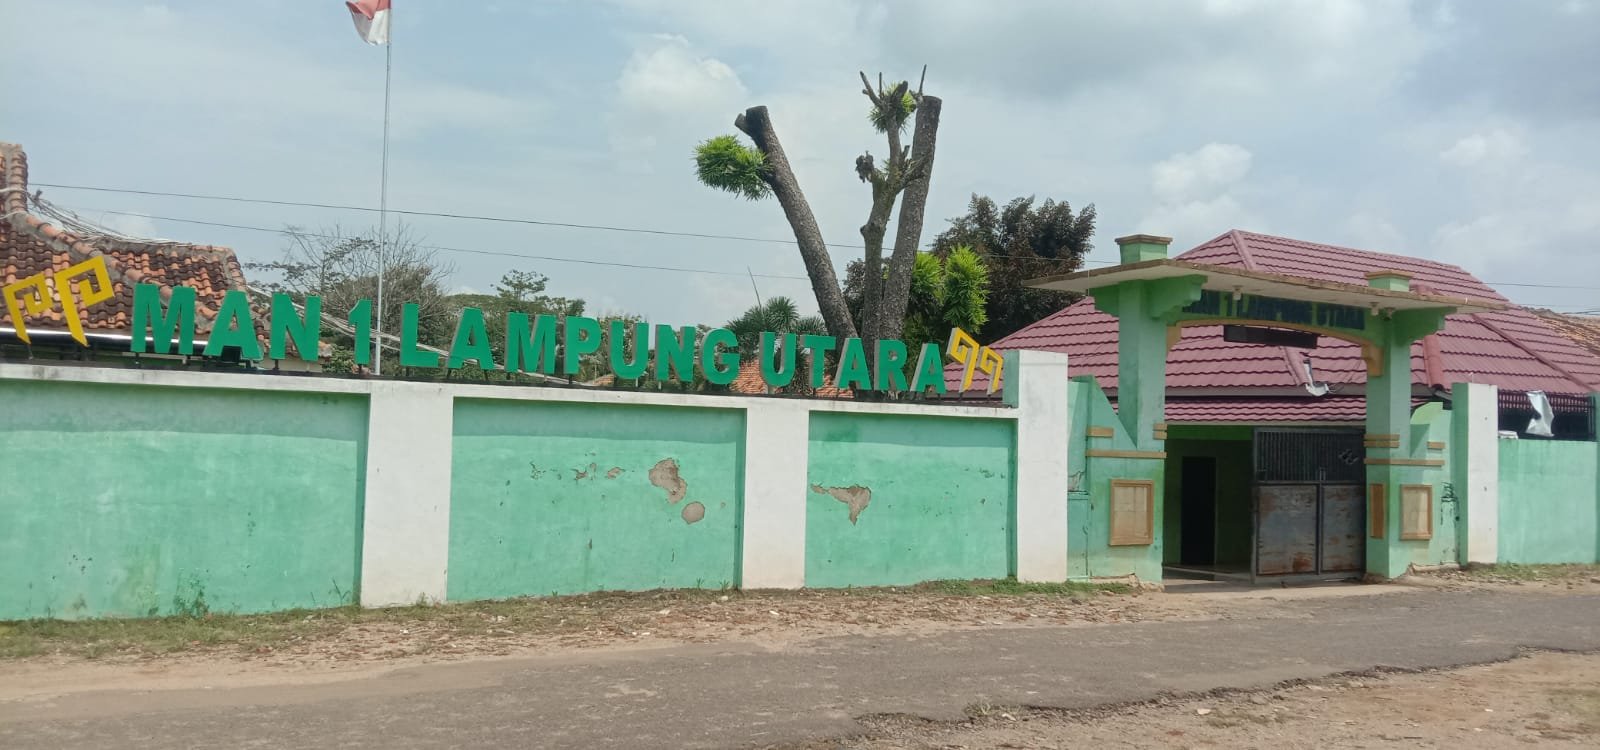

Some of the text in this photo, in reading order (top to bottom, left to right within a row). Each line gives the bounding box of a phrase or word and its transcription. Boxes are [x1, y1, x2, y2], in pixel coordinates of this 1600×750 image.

[130, 283, 946, 394] MAN 1 LAMPUNG UTARA
